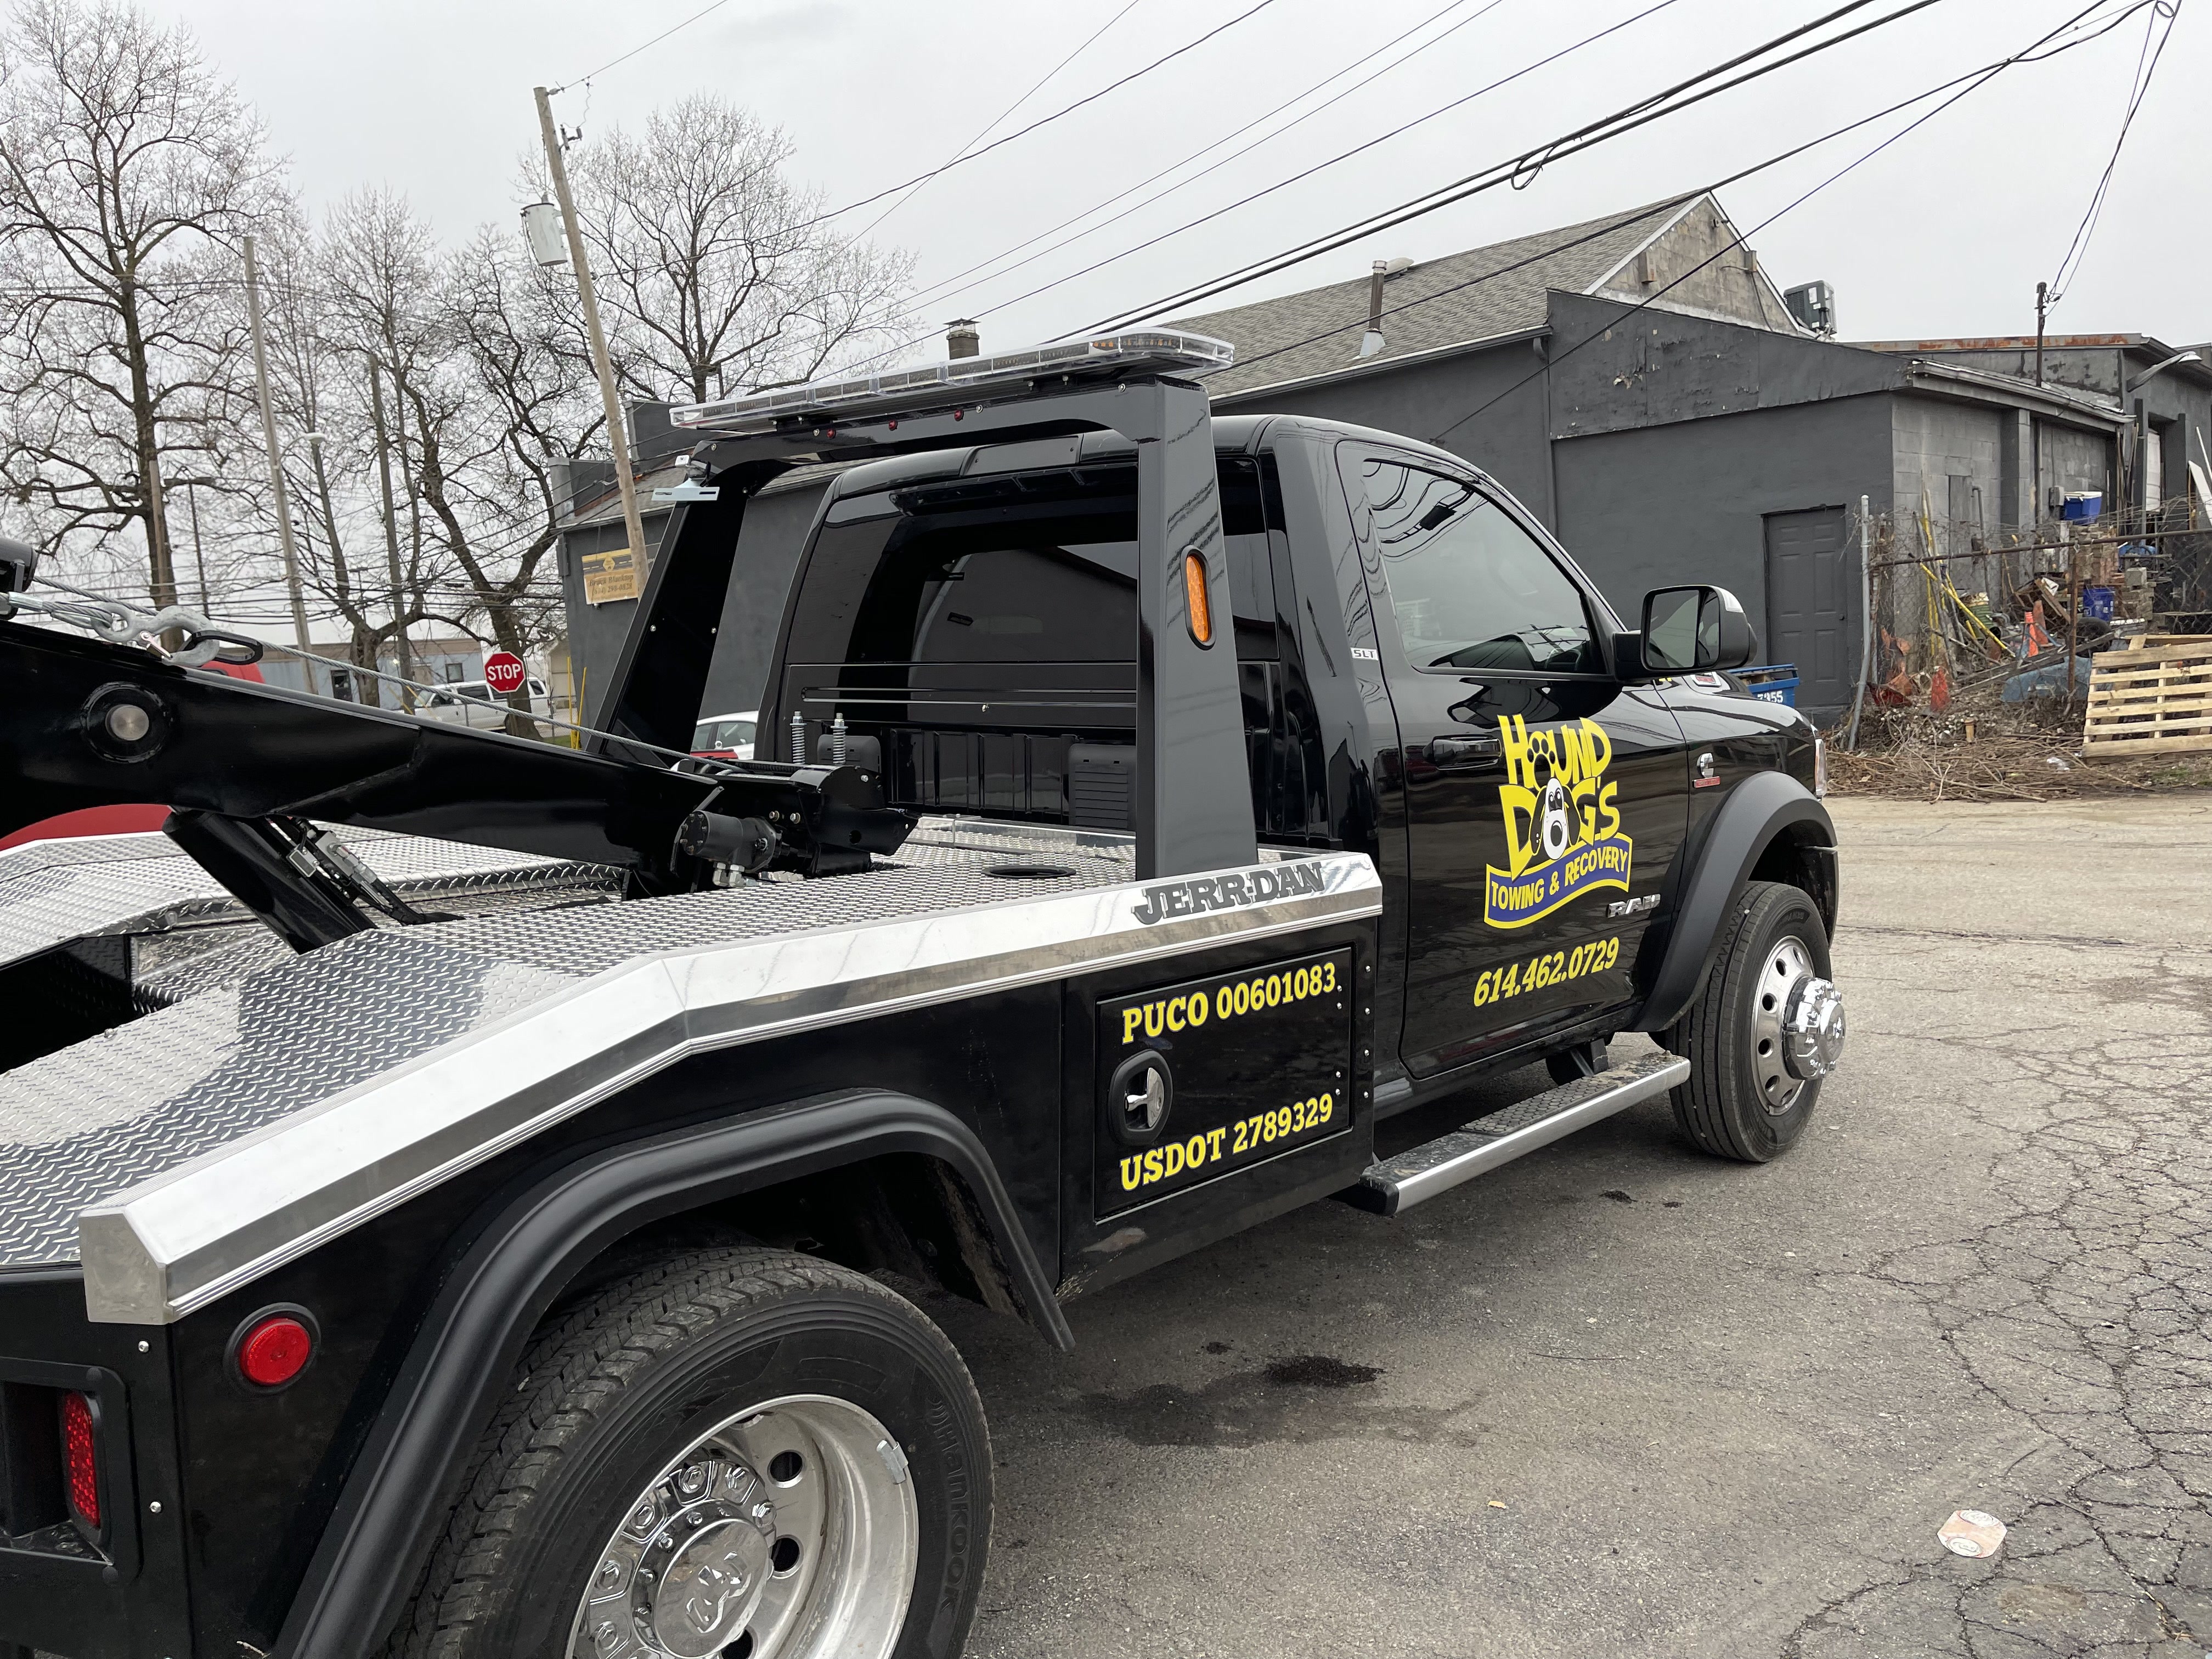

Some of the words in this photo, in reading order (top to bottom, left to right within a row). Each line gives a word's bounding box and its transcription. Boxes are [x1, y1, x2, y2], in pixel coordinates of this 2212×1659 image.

[487, 663, 521, 681] STOP
[1353, 650, 1374, 658] SLT
[1491, 878, 1544, 911] TOWING
[1549, 871, 1560, 895] &
[1564, 846, 1629, 888] RECOVERY
[1606, 893, 1661, 918] RAM
[1122, 991, 1209, 1045] PUCO
[1216, 961, 1336, 1020] 00601083
[1474, 936, 1619, 1007] 614.462.0729
[1120, 1126, 1226, 1192] USDOT
[1232, 1092, 1333, 1155] 2789329
